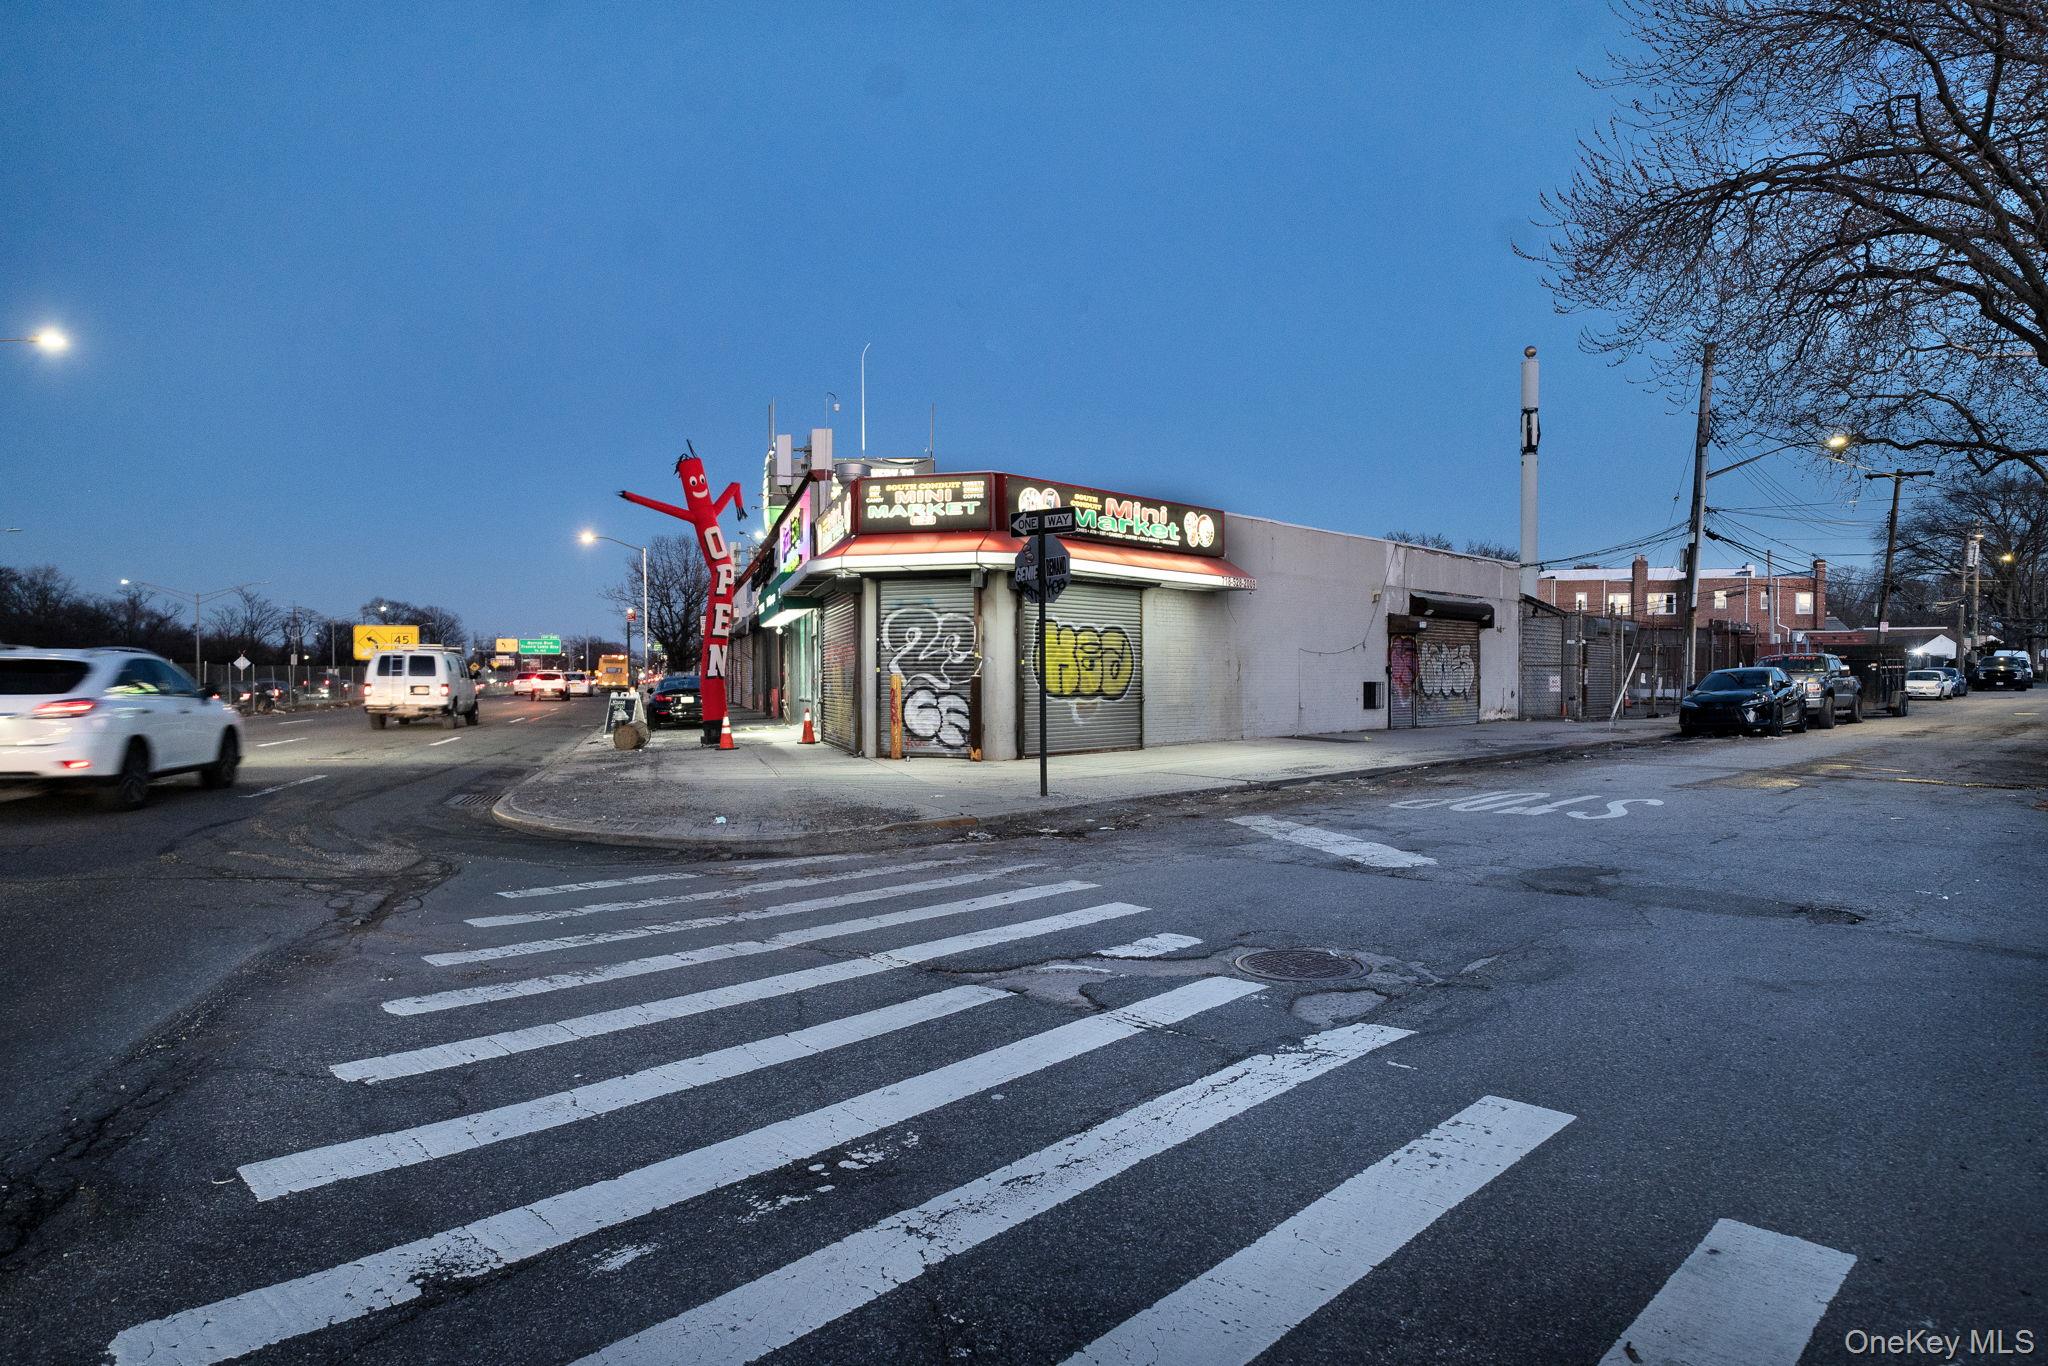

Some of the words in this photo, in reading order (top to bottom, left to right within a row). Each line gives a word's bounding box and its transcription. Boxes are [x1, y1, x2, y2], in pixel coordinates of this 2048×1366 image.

[885, 482, 917, 491] SOUTH
[918, 481, 961, 490] CONDUIT
[894, 488, 953, 504] MINI
[1074, 493, 1098, 503] SOUTH
[867, 501, 981, 519] MARKET
[1070, 500, 1102, 510] CONDUIT
[1105, 497, 1168, 525] Mini
[1018, 517, 1037, 529] ONE
[1048, 514, 1070, 526] WAY
[1075, 508, 1181, 541] Market
[1015, 564, 1039, 582] GENIE
[703, 525, 735, 679] OPEN
[394, 635, 410, 645] 45
